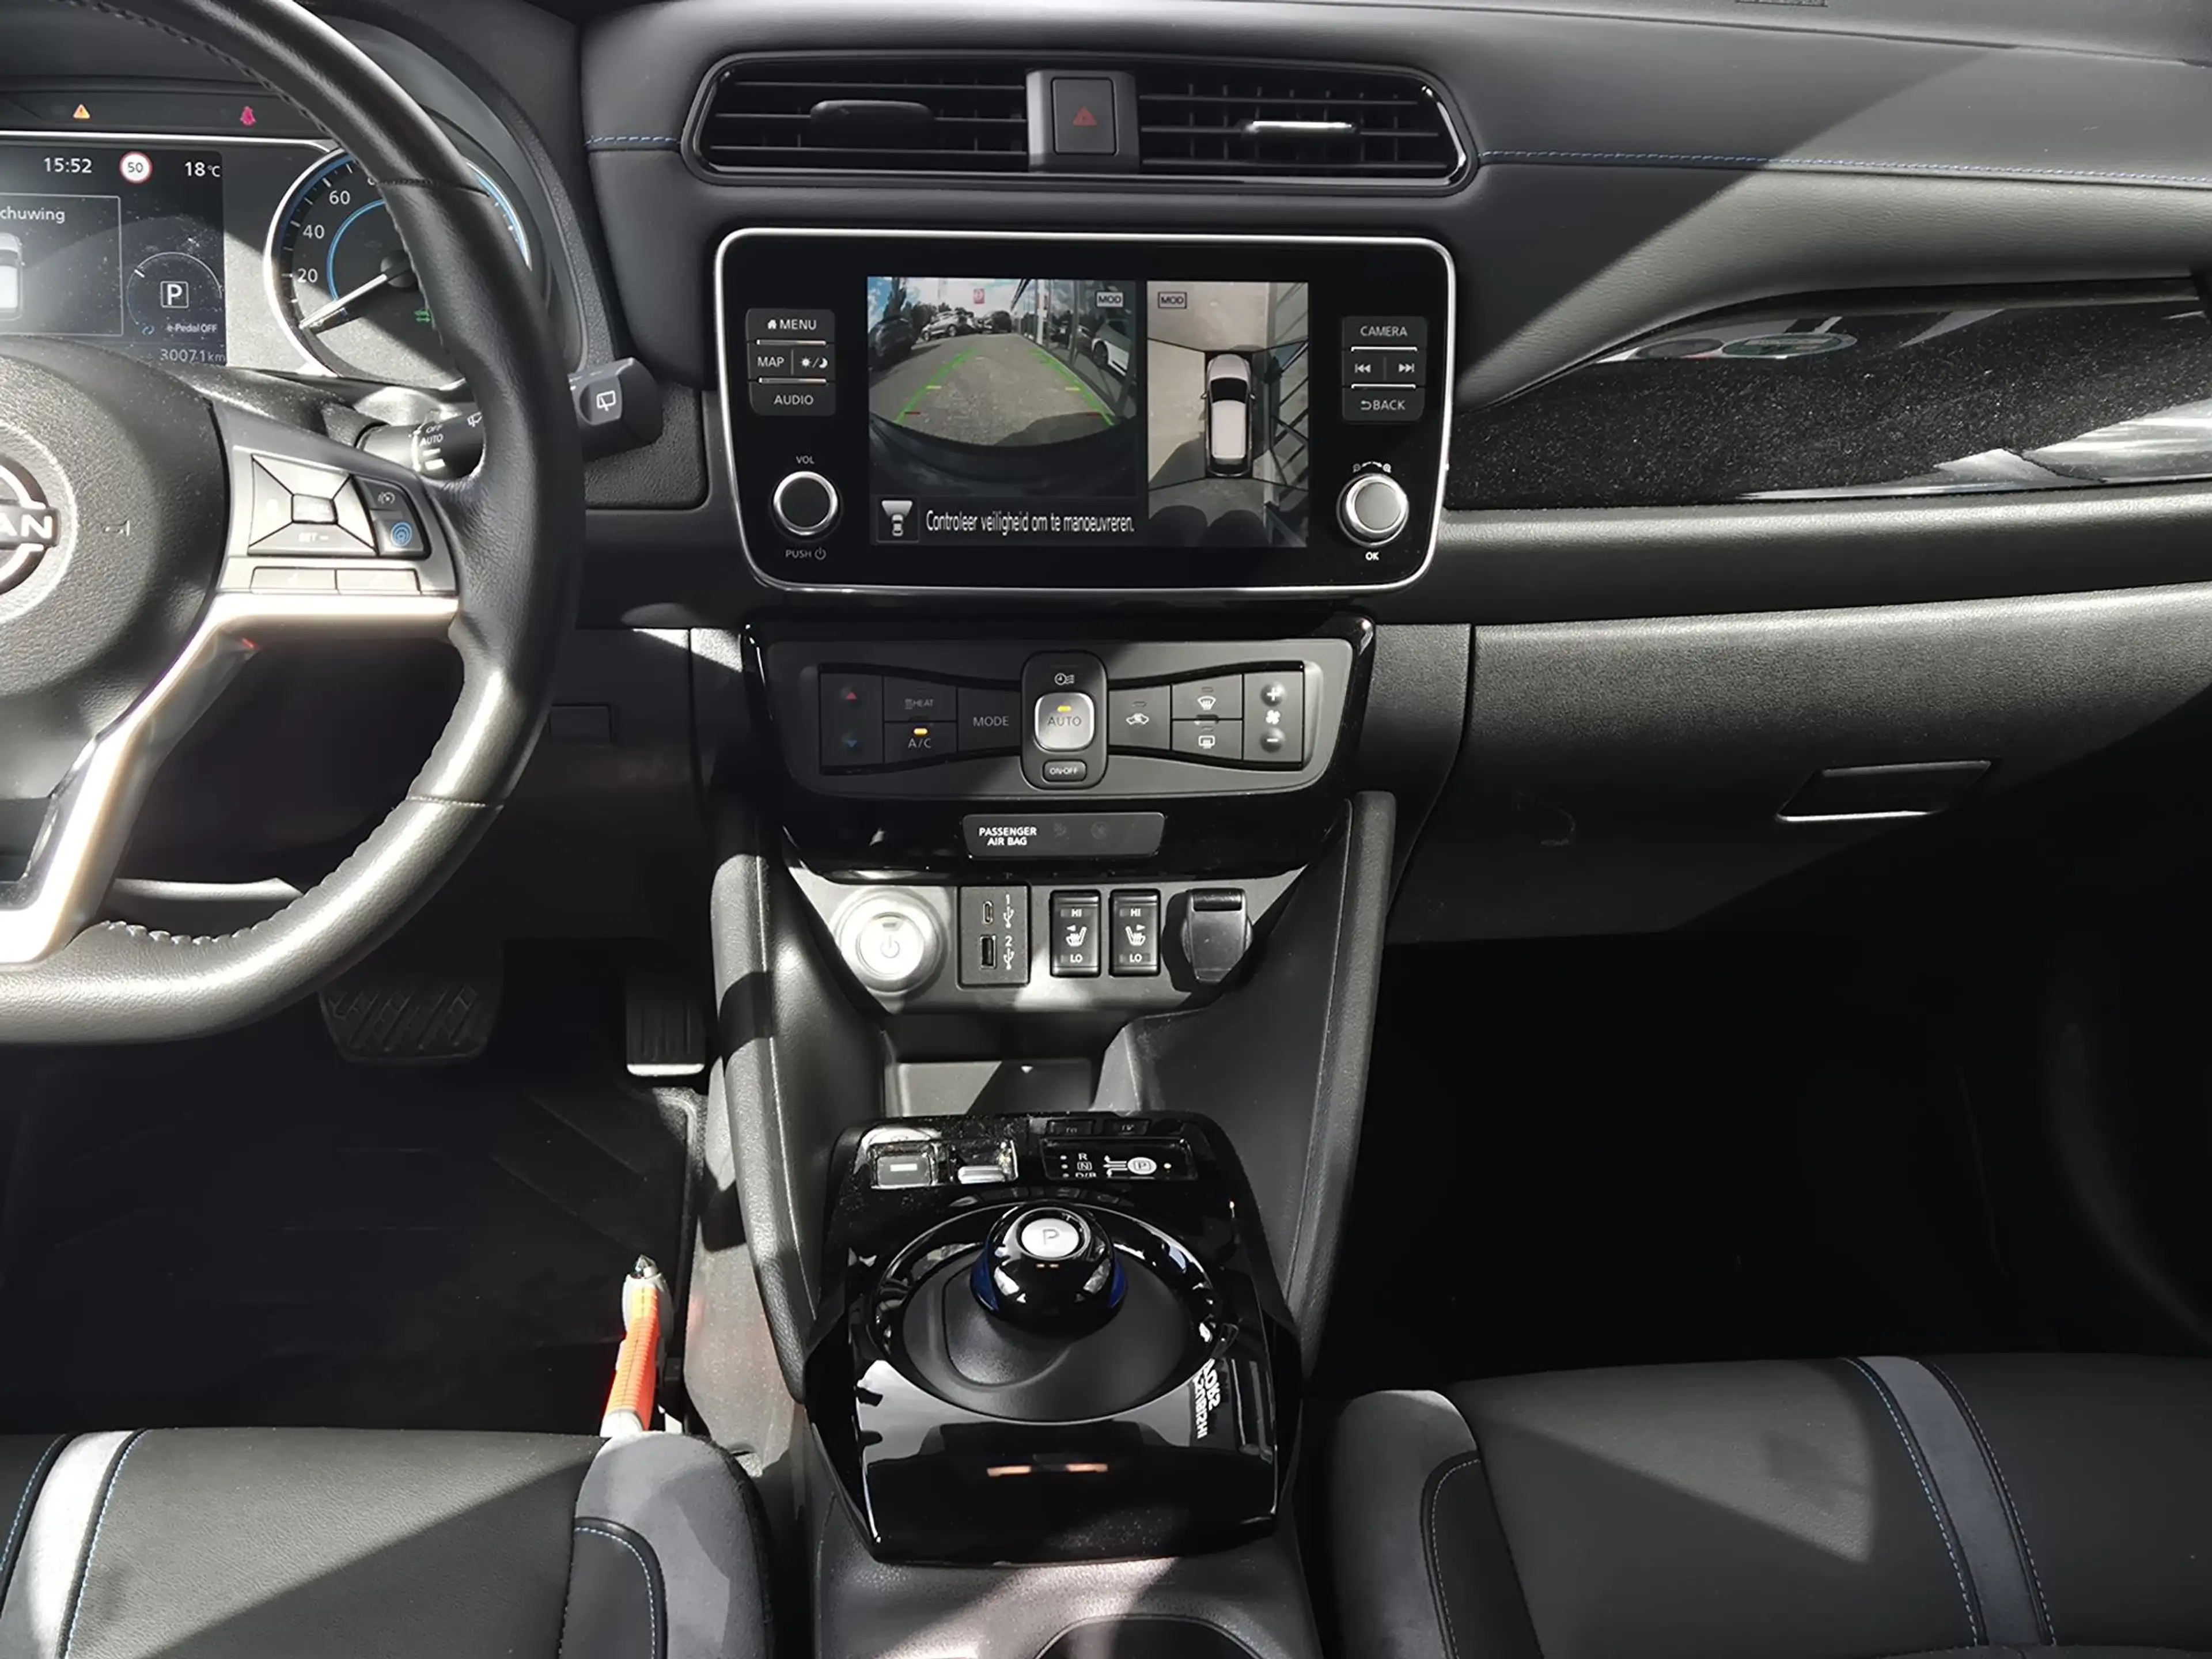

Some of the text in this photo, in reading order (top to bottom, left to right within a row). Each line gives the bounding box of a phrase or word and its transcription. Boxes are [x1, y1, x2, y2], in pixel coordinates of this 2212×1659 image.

[43, 157, 93, 173] 15:52
[127, 162, 143, 173] 50
[329, 190, 351, 205] 60
[0, 206, 66, 224] chuwing
[302, 224, 325, 240] 40
[297, 267, 318, 283] 20
[167, 283, 183, 306] P
[1098, 295, 1122, 304] MOD
[1161, 296, 1184, 304] MOD
[200, 323, 218, 333] OFF
[779, 319, 817, 330] MENU
[1360, 325, 1408, 336] CAMERA
[757, 356, 785, 368] MAP
[774, 394, 814, 406] AUDIO
[1373, 399, 1406, 411] BACK
[419, 433, 444, 447] AUTO
[796, 455, 815, 464] VOL
[926, 510, 978, 532] Controleer
[980, 510, 1028, 536] veiligheid
[1031, 515, 1047, 532] om
[1050, 513, 1061, 532] te
[785, 549, 812, 559] PUSH
[1365, 551, 1380, 561] OK
[972, 715, 1010, 727] MODE
[1047, 716, 1082, 727] AUTO
[908, 737, 933, 749] A/C
[979, 827, 1037, 836] PASSENGER
[987, 836, 1028, 846] AIR BAG
[1005, 894, 1010, 905] 1
[1071, 908, 1082, 918] HI
[1130, 908, 1141, 917] HI
[1005, 935, 1013, 947] 2
[1070, 953, 1084, 964] LO
[1129, 953, 1143, 963] LO
[1078, 1153, 1088, 1161] R
[1042, 1228, 1060, 1245] P
